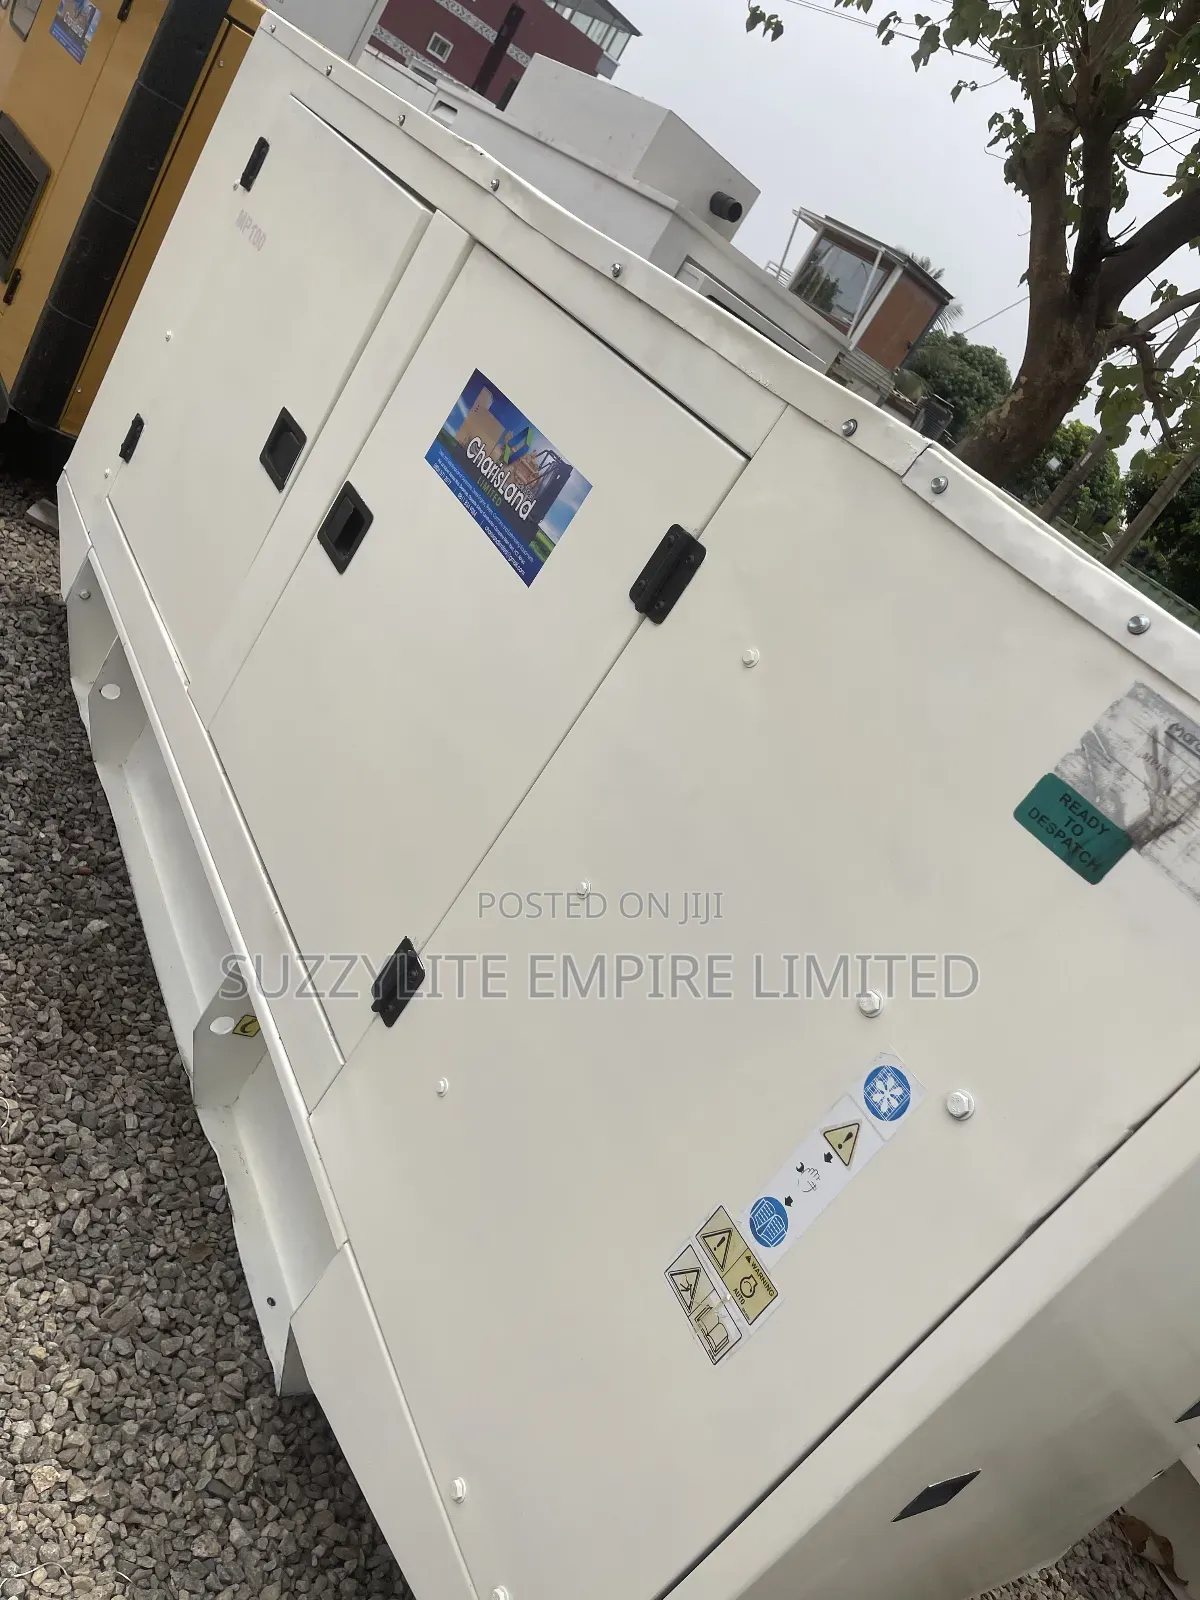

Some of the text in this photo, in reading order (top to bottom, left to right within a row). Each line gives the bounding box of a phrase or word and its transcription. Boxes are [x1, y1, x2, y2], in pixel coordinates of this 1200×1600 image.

[466, 436, 537, 521] CharisLand
[477, 474, 502, 507] LIMITED
[1059, 793, 1111, 837] READY
[1064, 816, 1084, 837] TO
[1028, 807, 1104, 873] DESPATCH
[732, 1287, 746, 1306] AUTO
[751, 1261, 775, 1297] WARNING
